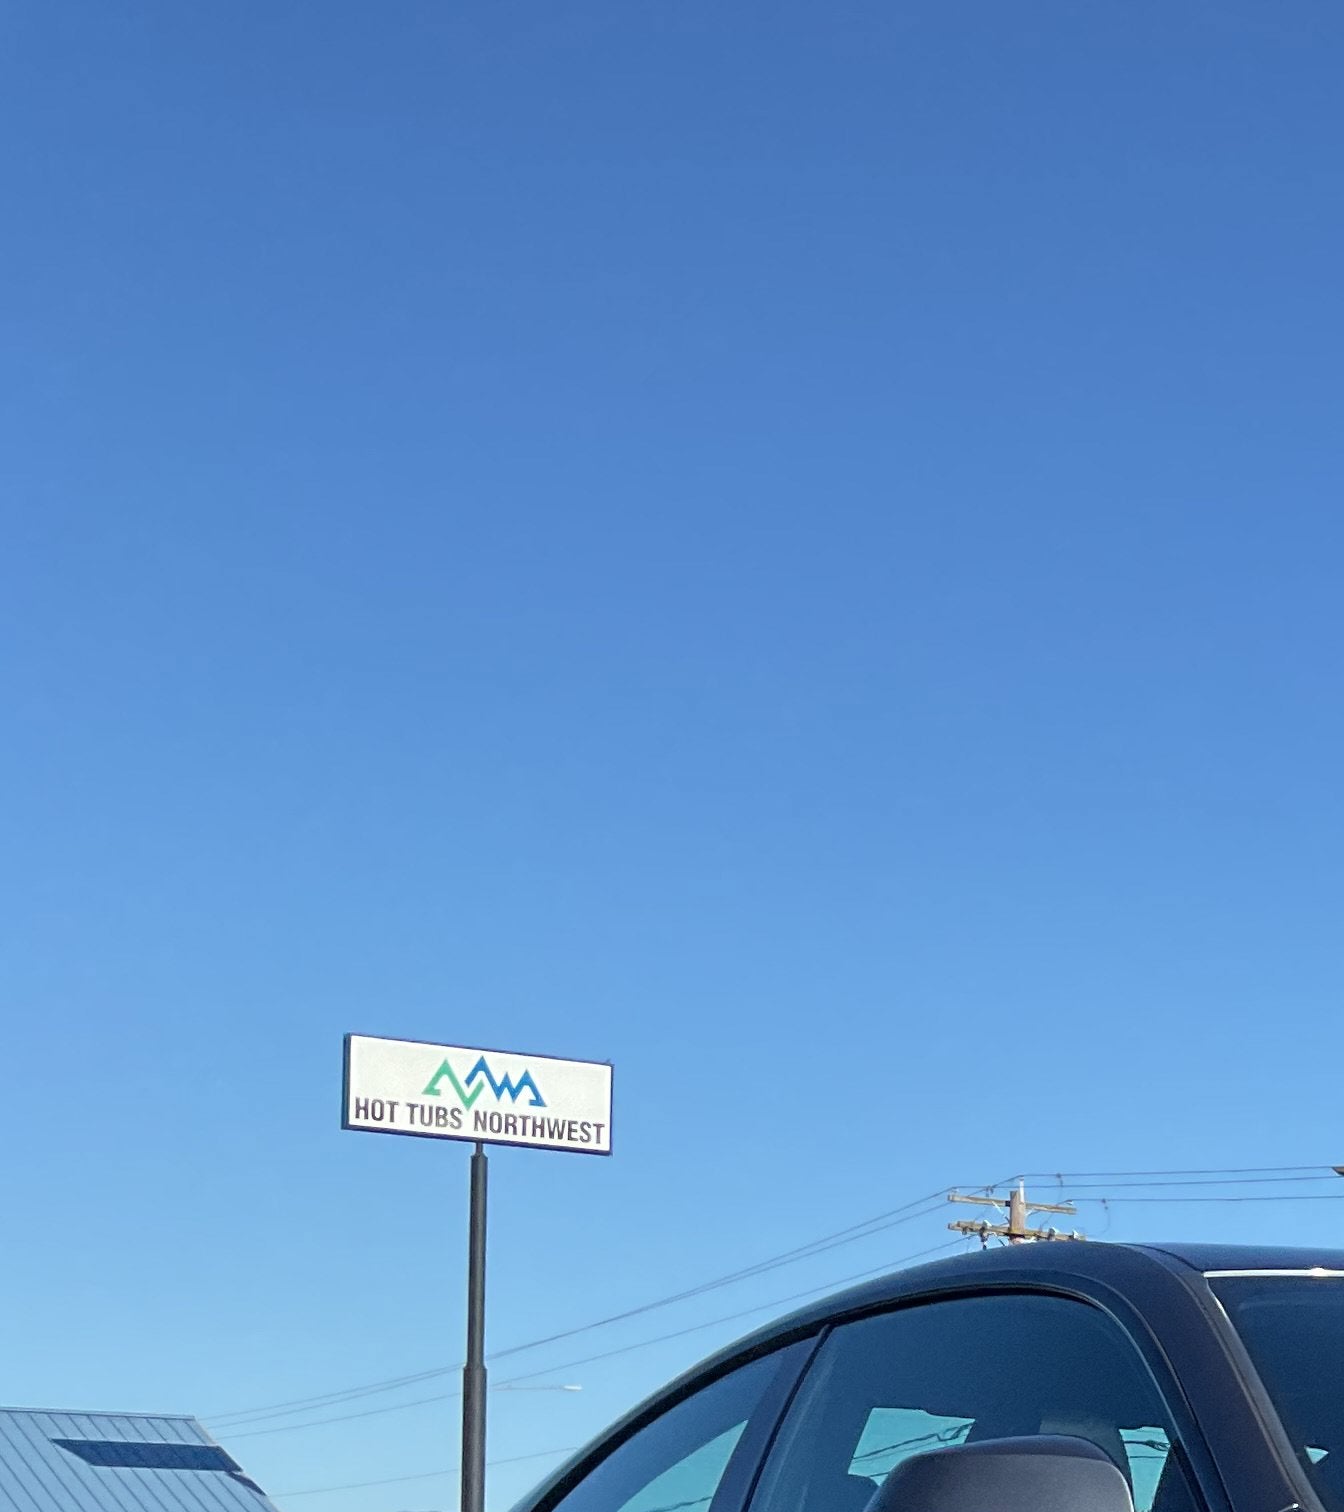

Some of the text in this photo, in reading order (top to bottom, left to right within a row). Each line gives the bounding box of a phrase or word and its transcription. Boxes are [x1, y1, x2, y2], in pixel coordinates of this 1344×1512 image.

[354, 1096, 606, 1145] HOT TUBS NORTHWEST
